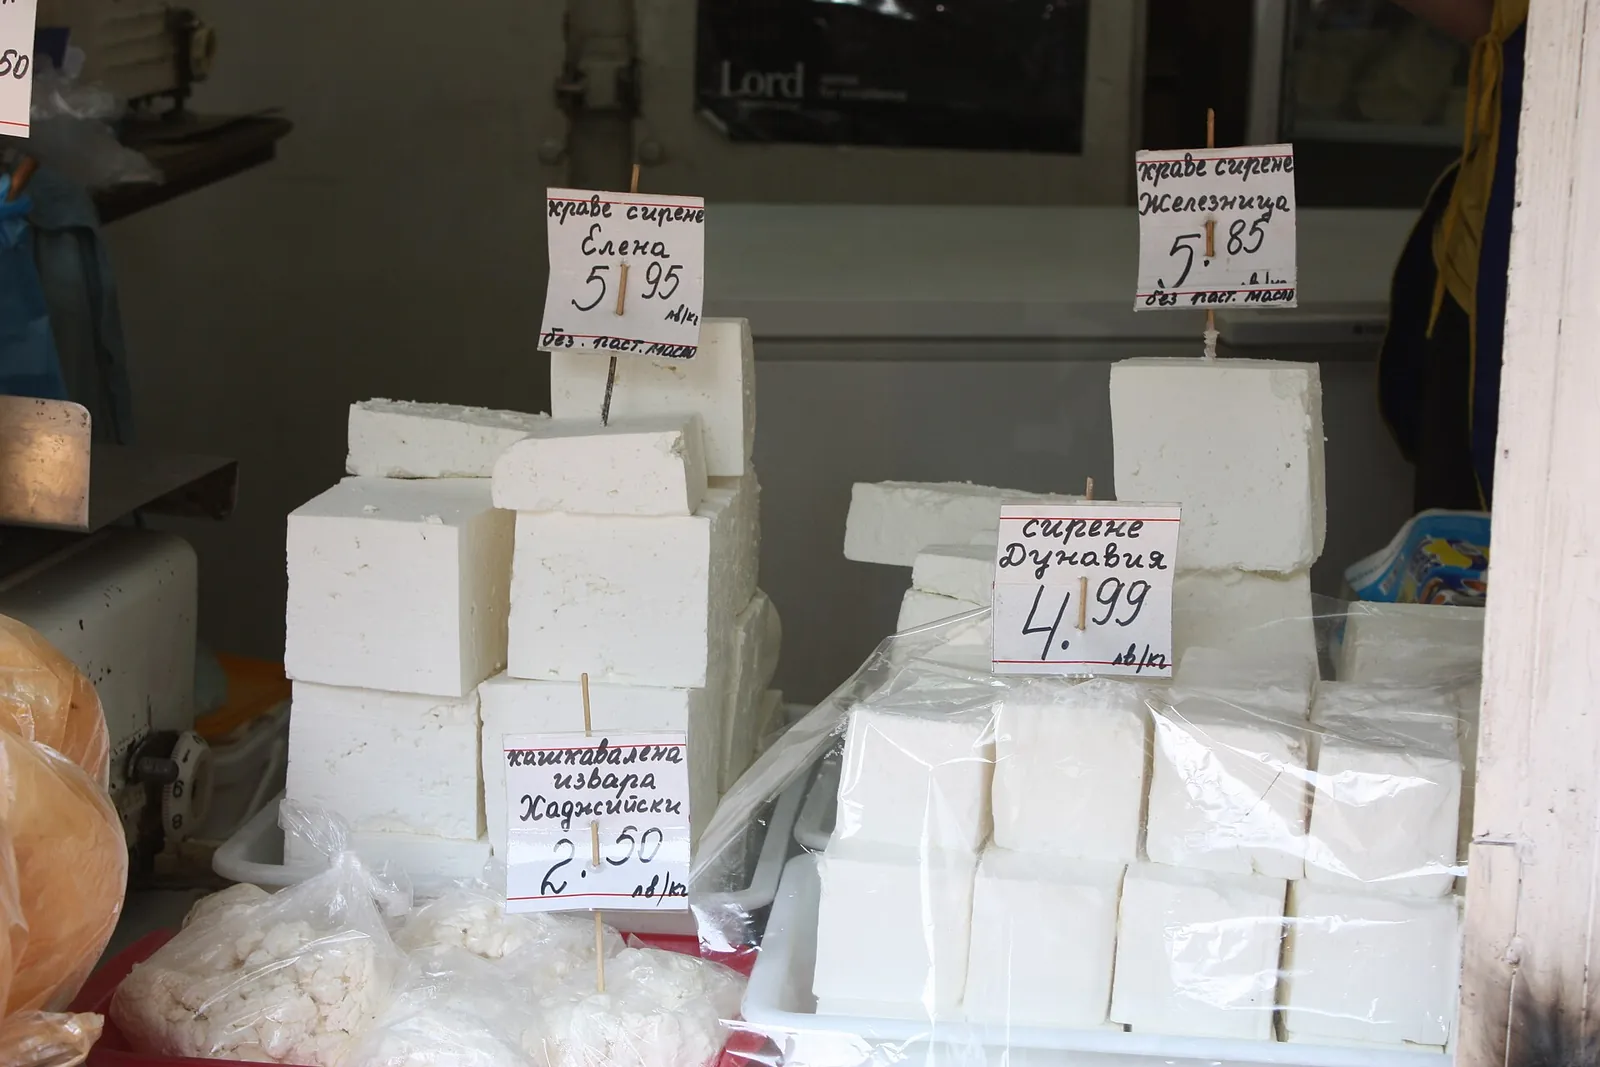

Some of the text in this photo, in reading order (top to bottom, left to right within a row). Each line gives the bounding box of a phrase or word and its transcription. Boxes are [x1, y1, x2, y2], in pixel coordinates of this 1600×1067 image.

[719, 59, 805, 98] Lord
[1138, 152, 1294, 188] краве сирене
[548, 194, 704, 228] краве сирене
[1138, 191, 1291, 222] Железница
[581, 223, 670, 259] Елена
[1145, 289, 1177, 306] без
[664, 303, 699, 326] лв/кг
[1022, 518, 1145, 546] сирене
[998, 542, 1168, 580] Дунавия
[1111, 642, 1168, 674] лв/кг
[506, 737, 684, 768] кашкавалена
[552, 766, 657, 799] извара
[519, 794, 683, 833] Хаджийски
[631, 870, 689, 908] лв/кг
